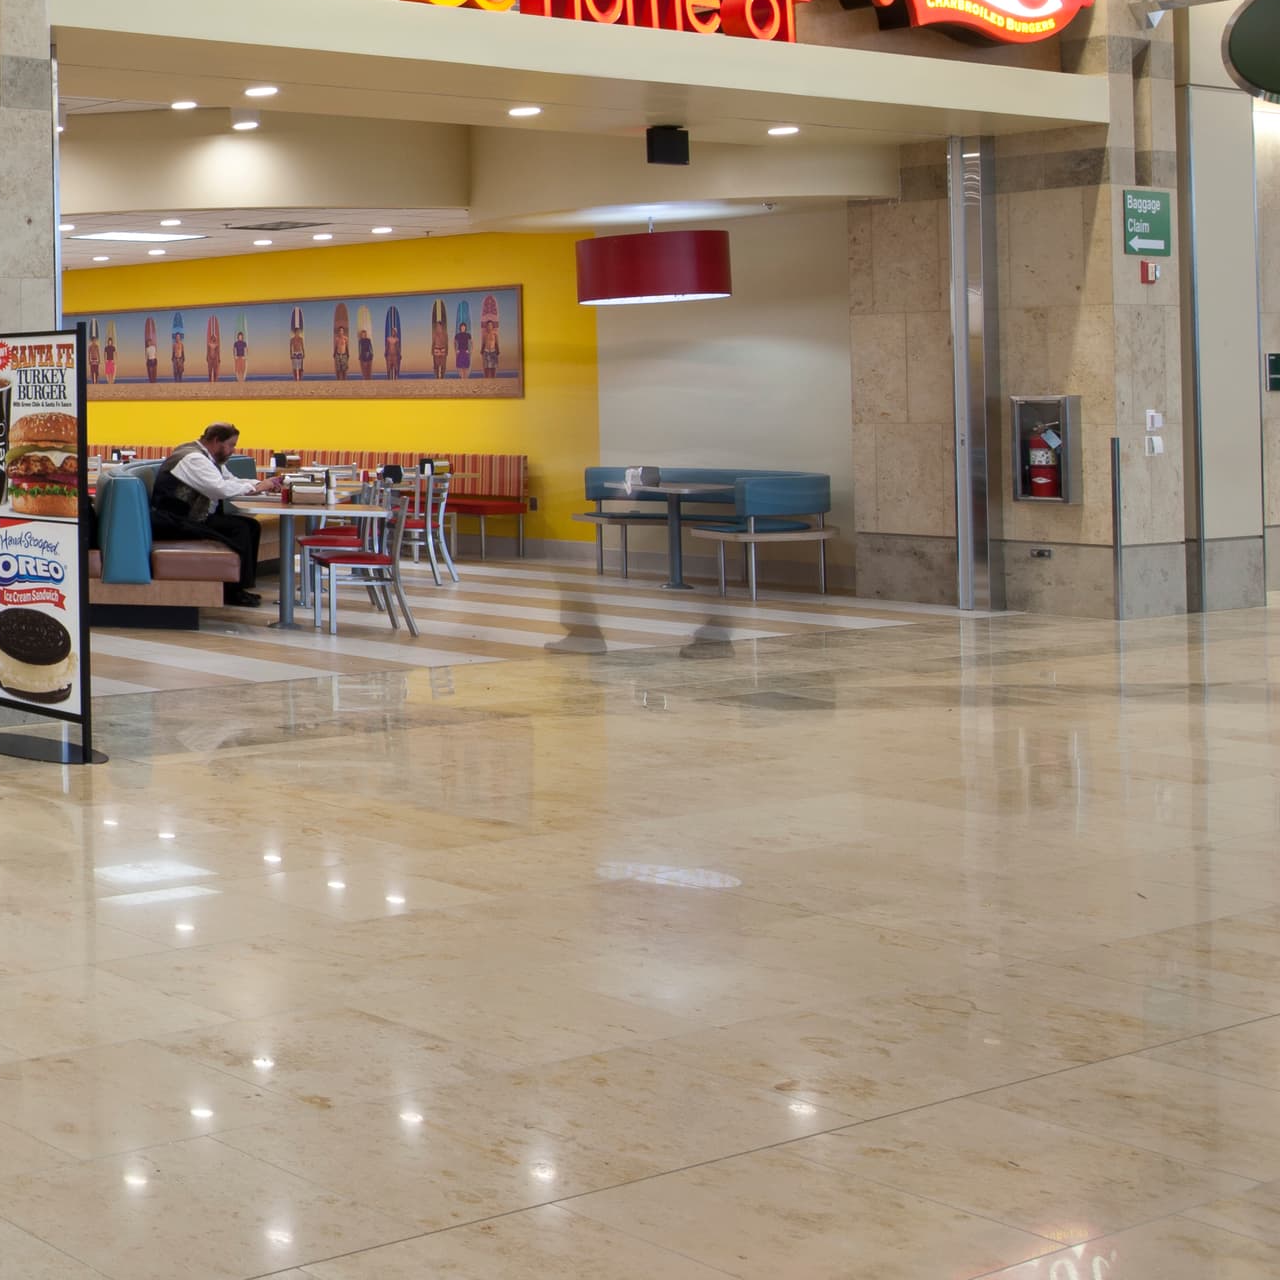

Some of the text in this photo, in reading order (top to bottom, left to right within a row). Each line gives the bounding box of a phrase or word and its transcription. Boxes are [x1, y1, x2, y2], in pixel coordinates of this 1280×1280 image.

[1005, 17, 1056, 34] BURGERS
[1127, 195, 1161, 214] Baggage
[1127, 218, 1150, 233] Claim
[11, 343, 74, 371] SANTA FE
[17, 368, 67, 385] TURKEY
[17, 385, 67, 401] BURGER
[3, 589, 59, 602] Ice Cream Sandwich
